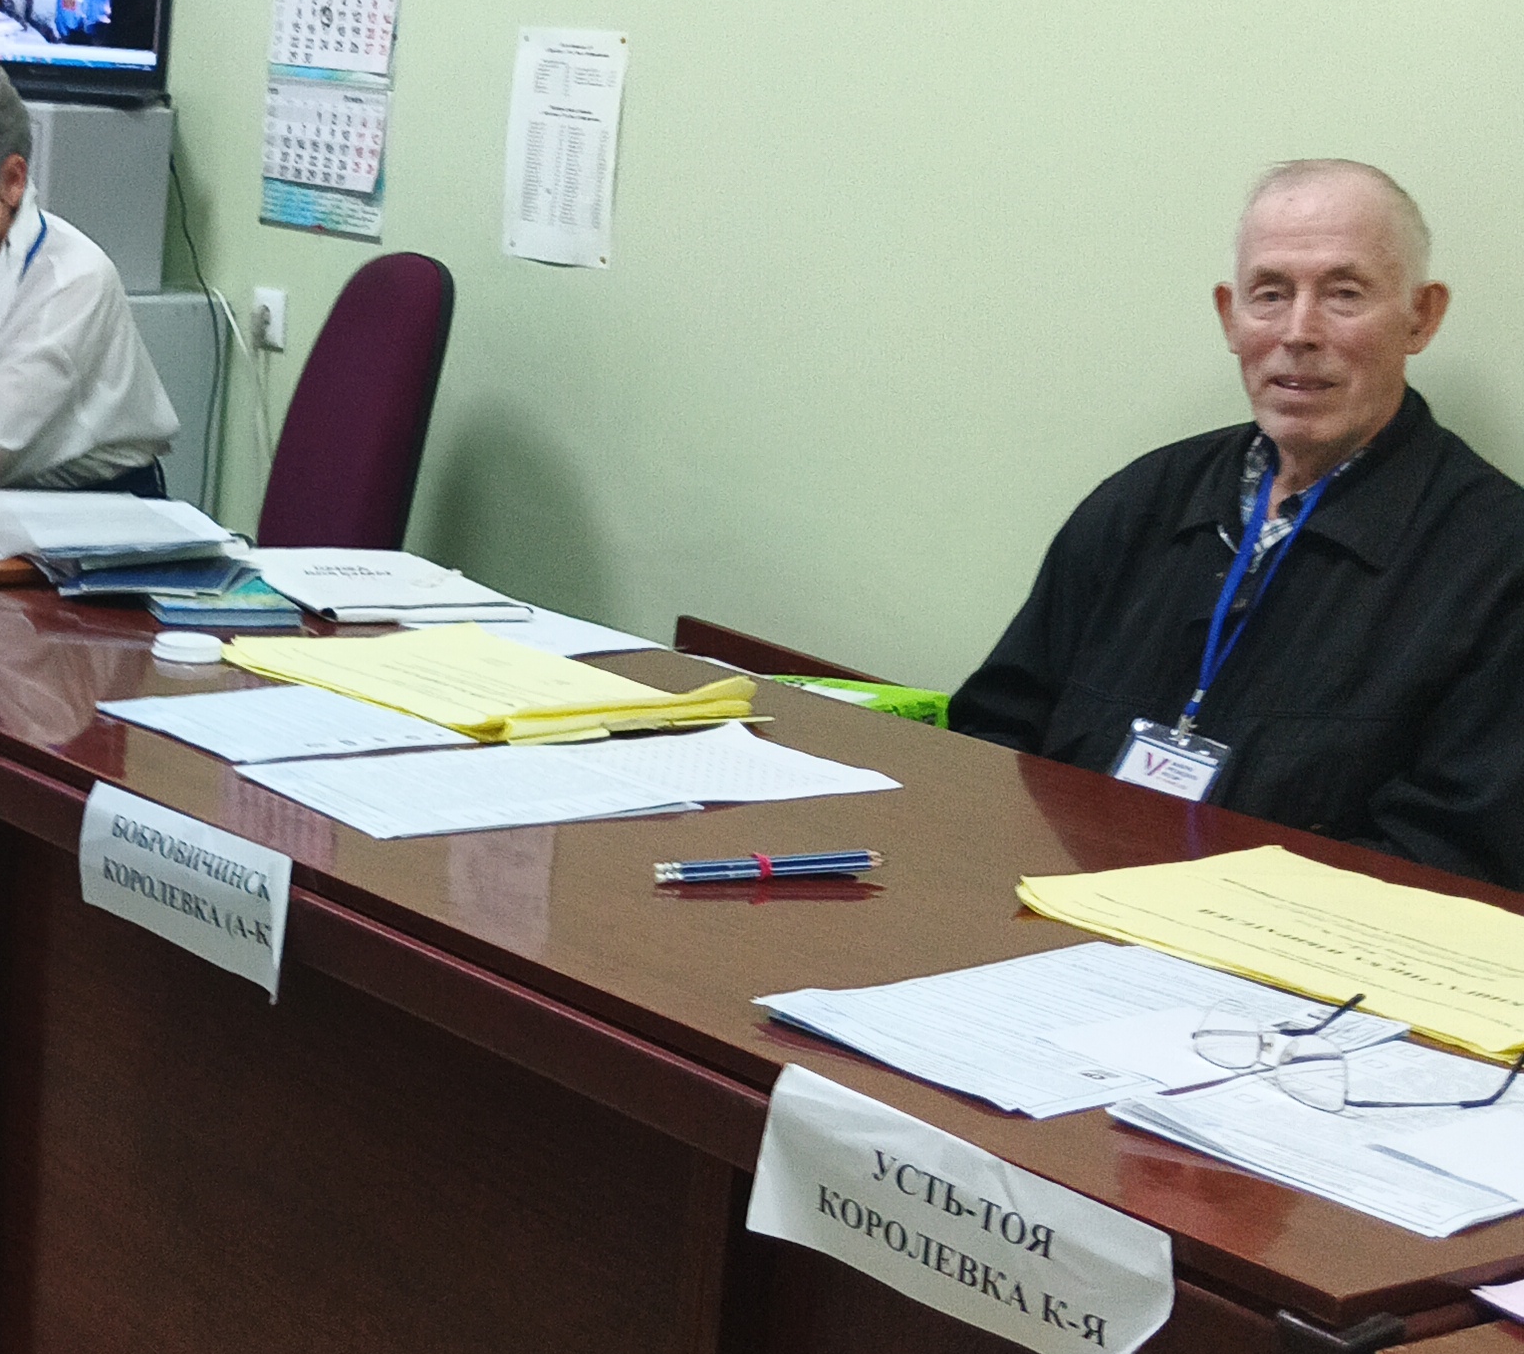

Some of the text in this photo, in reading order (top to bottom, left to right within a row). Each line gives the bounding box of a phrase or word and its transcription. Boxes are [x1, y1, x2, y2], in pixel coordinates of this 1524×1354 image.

[103, 855, 224, 930] КОРОЛЕВКА
[871, 1149, 1056, 1261] УСТЬ-ТОЯ
[816, 1183, 1109, 1349] КОРОЛЕВКА К-Я
